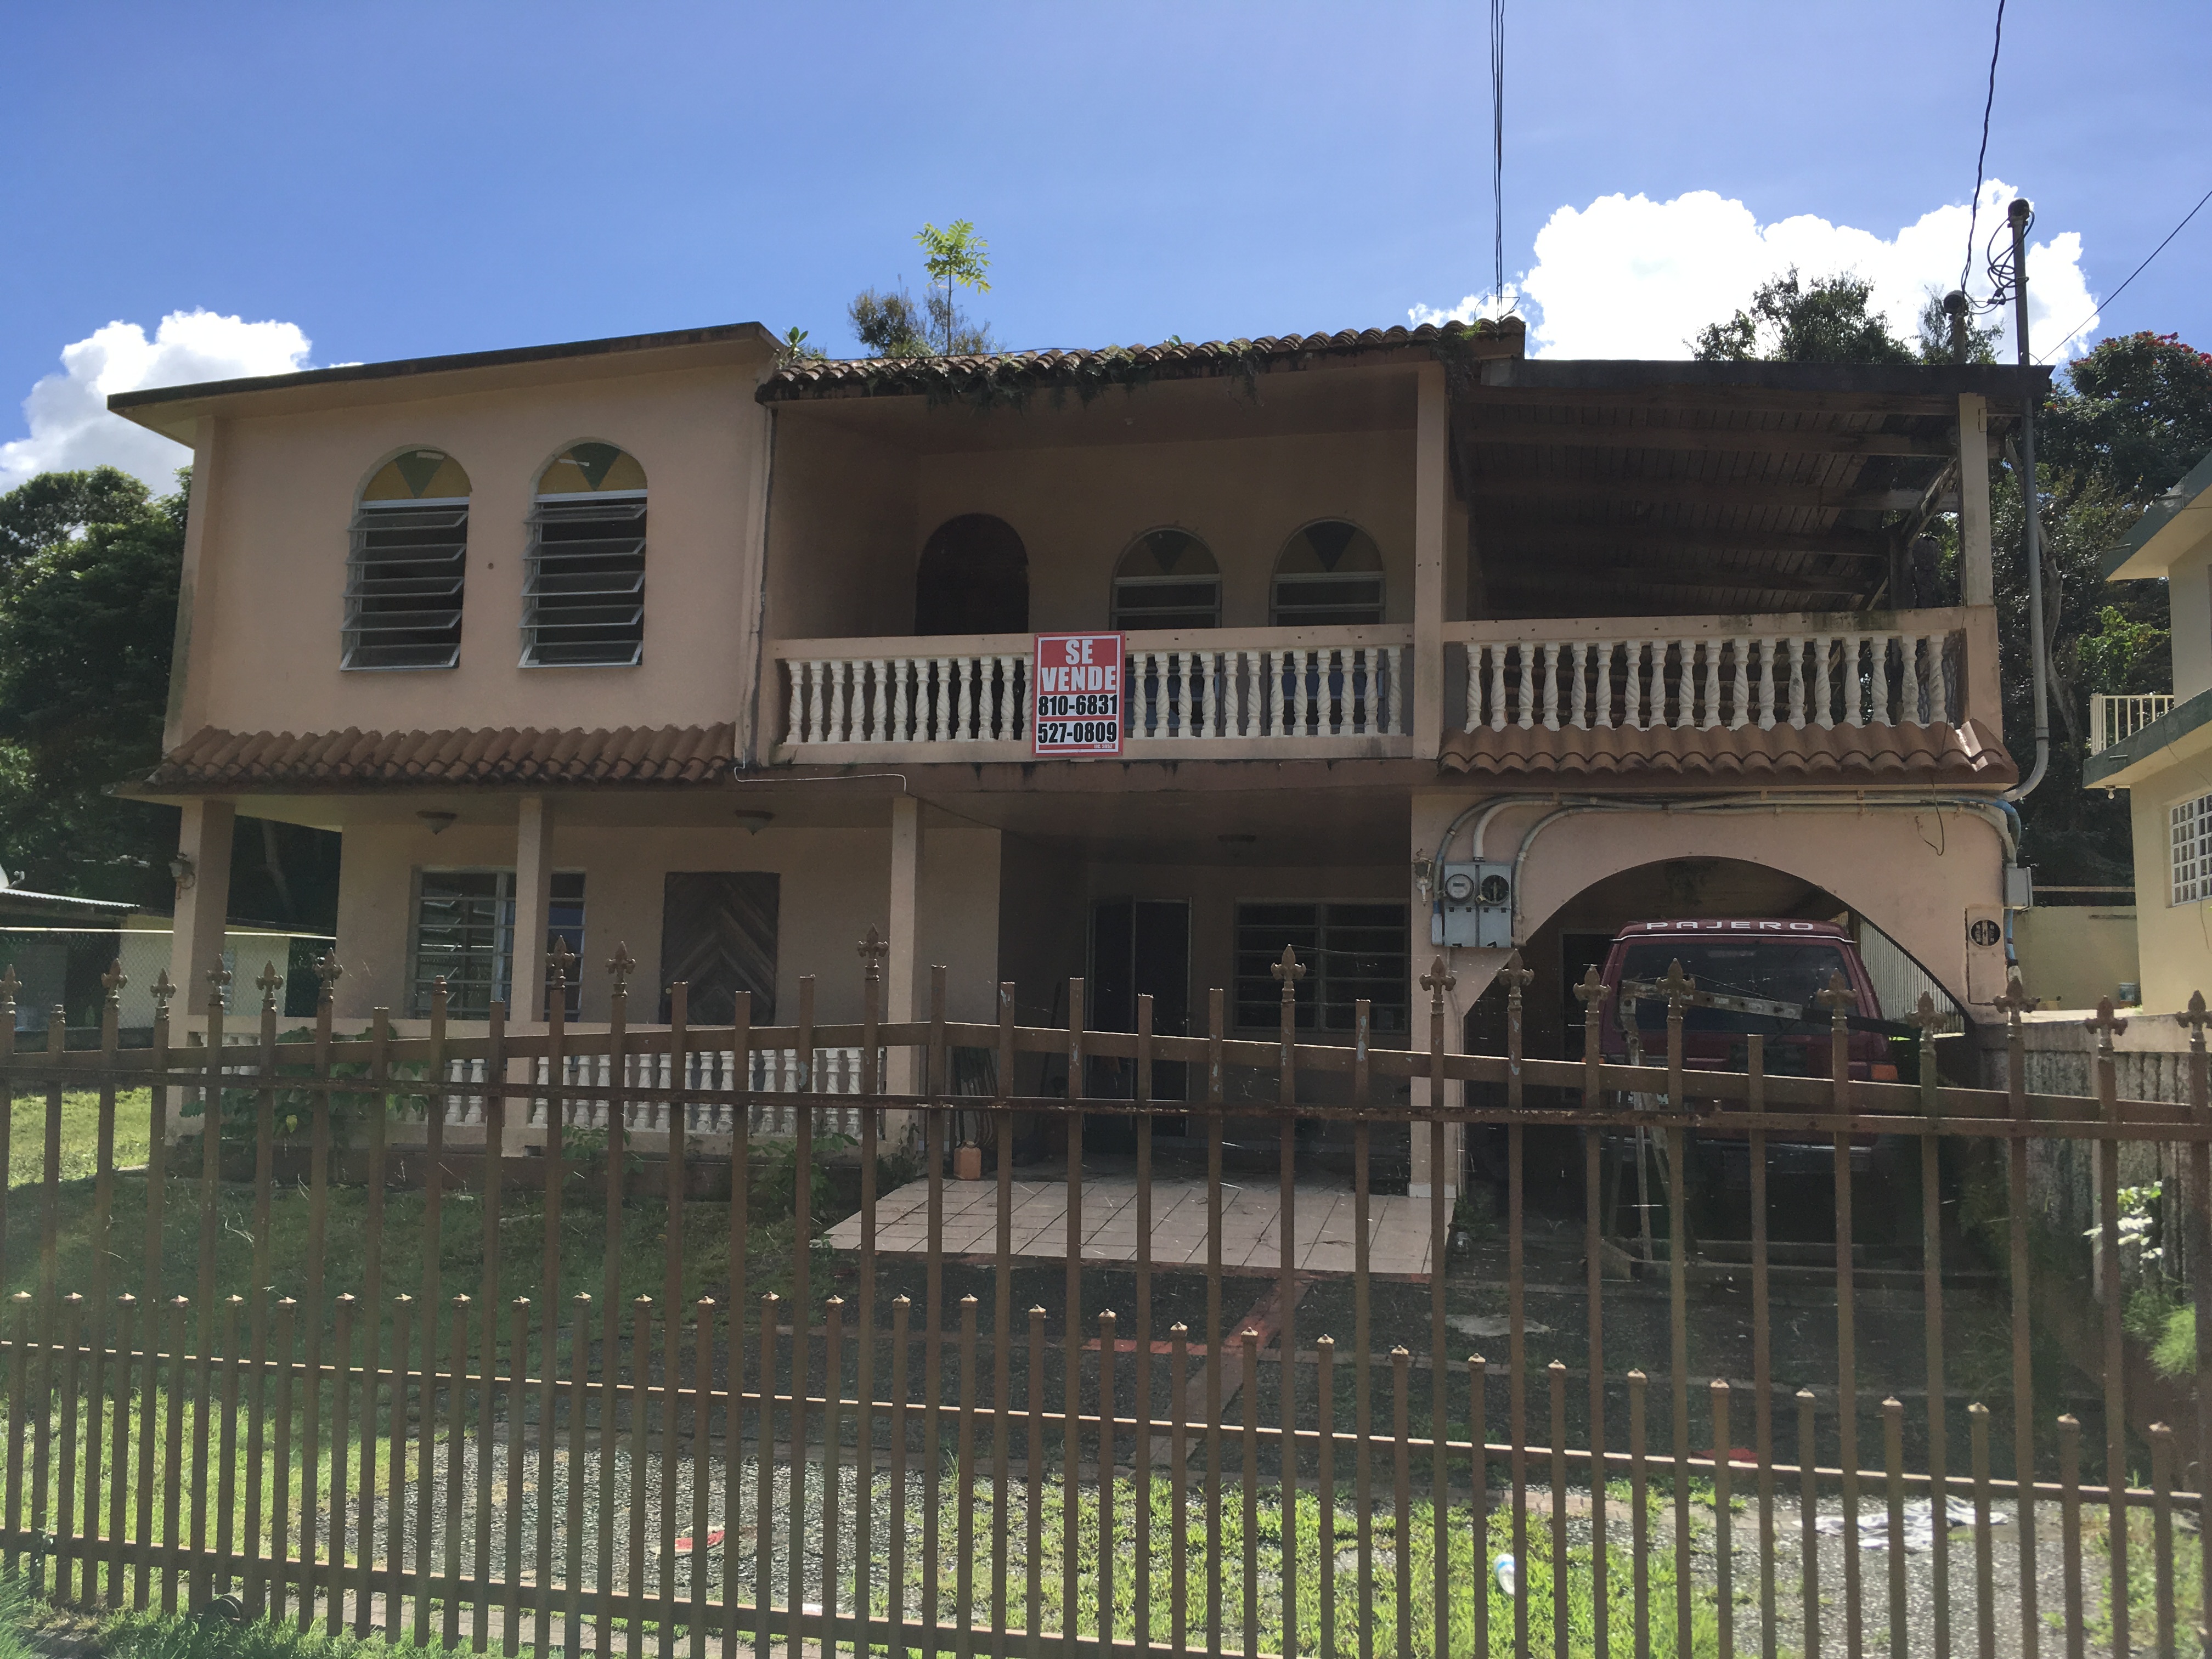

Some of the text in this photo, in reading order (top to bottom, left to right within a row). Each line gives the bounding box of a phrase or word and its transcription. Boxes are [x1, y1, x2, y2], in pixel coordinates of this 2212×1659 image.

[1065, 640, 1093, 665] SE
[1041, 665, 1116, 691] VENDE
[1039, 695, 1117, 716] 810-6831
[1037, 721, 1117, 743] 527-0809
[1646, 921, 1813, 930] PAJERO
